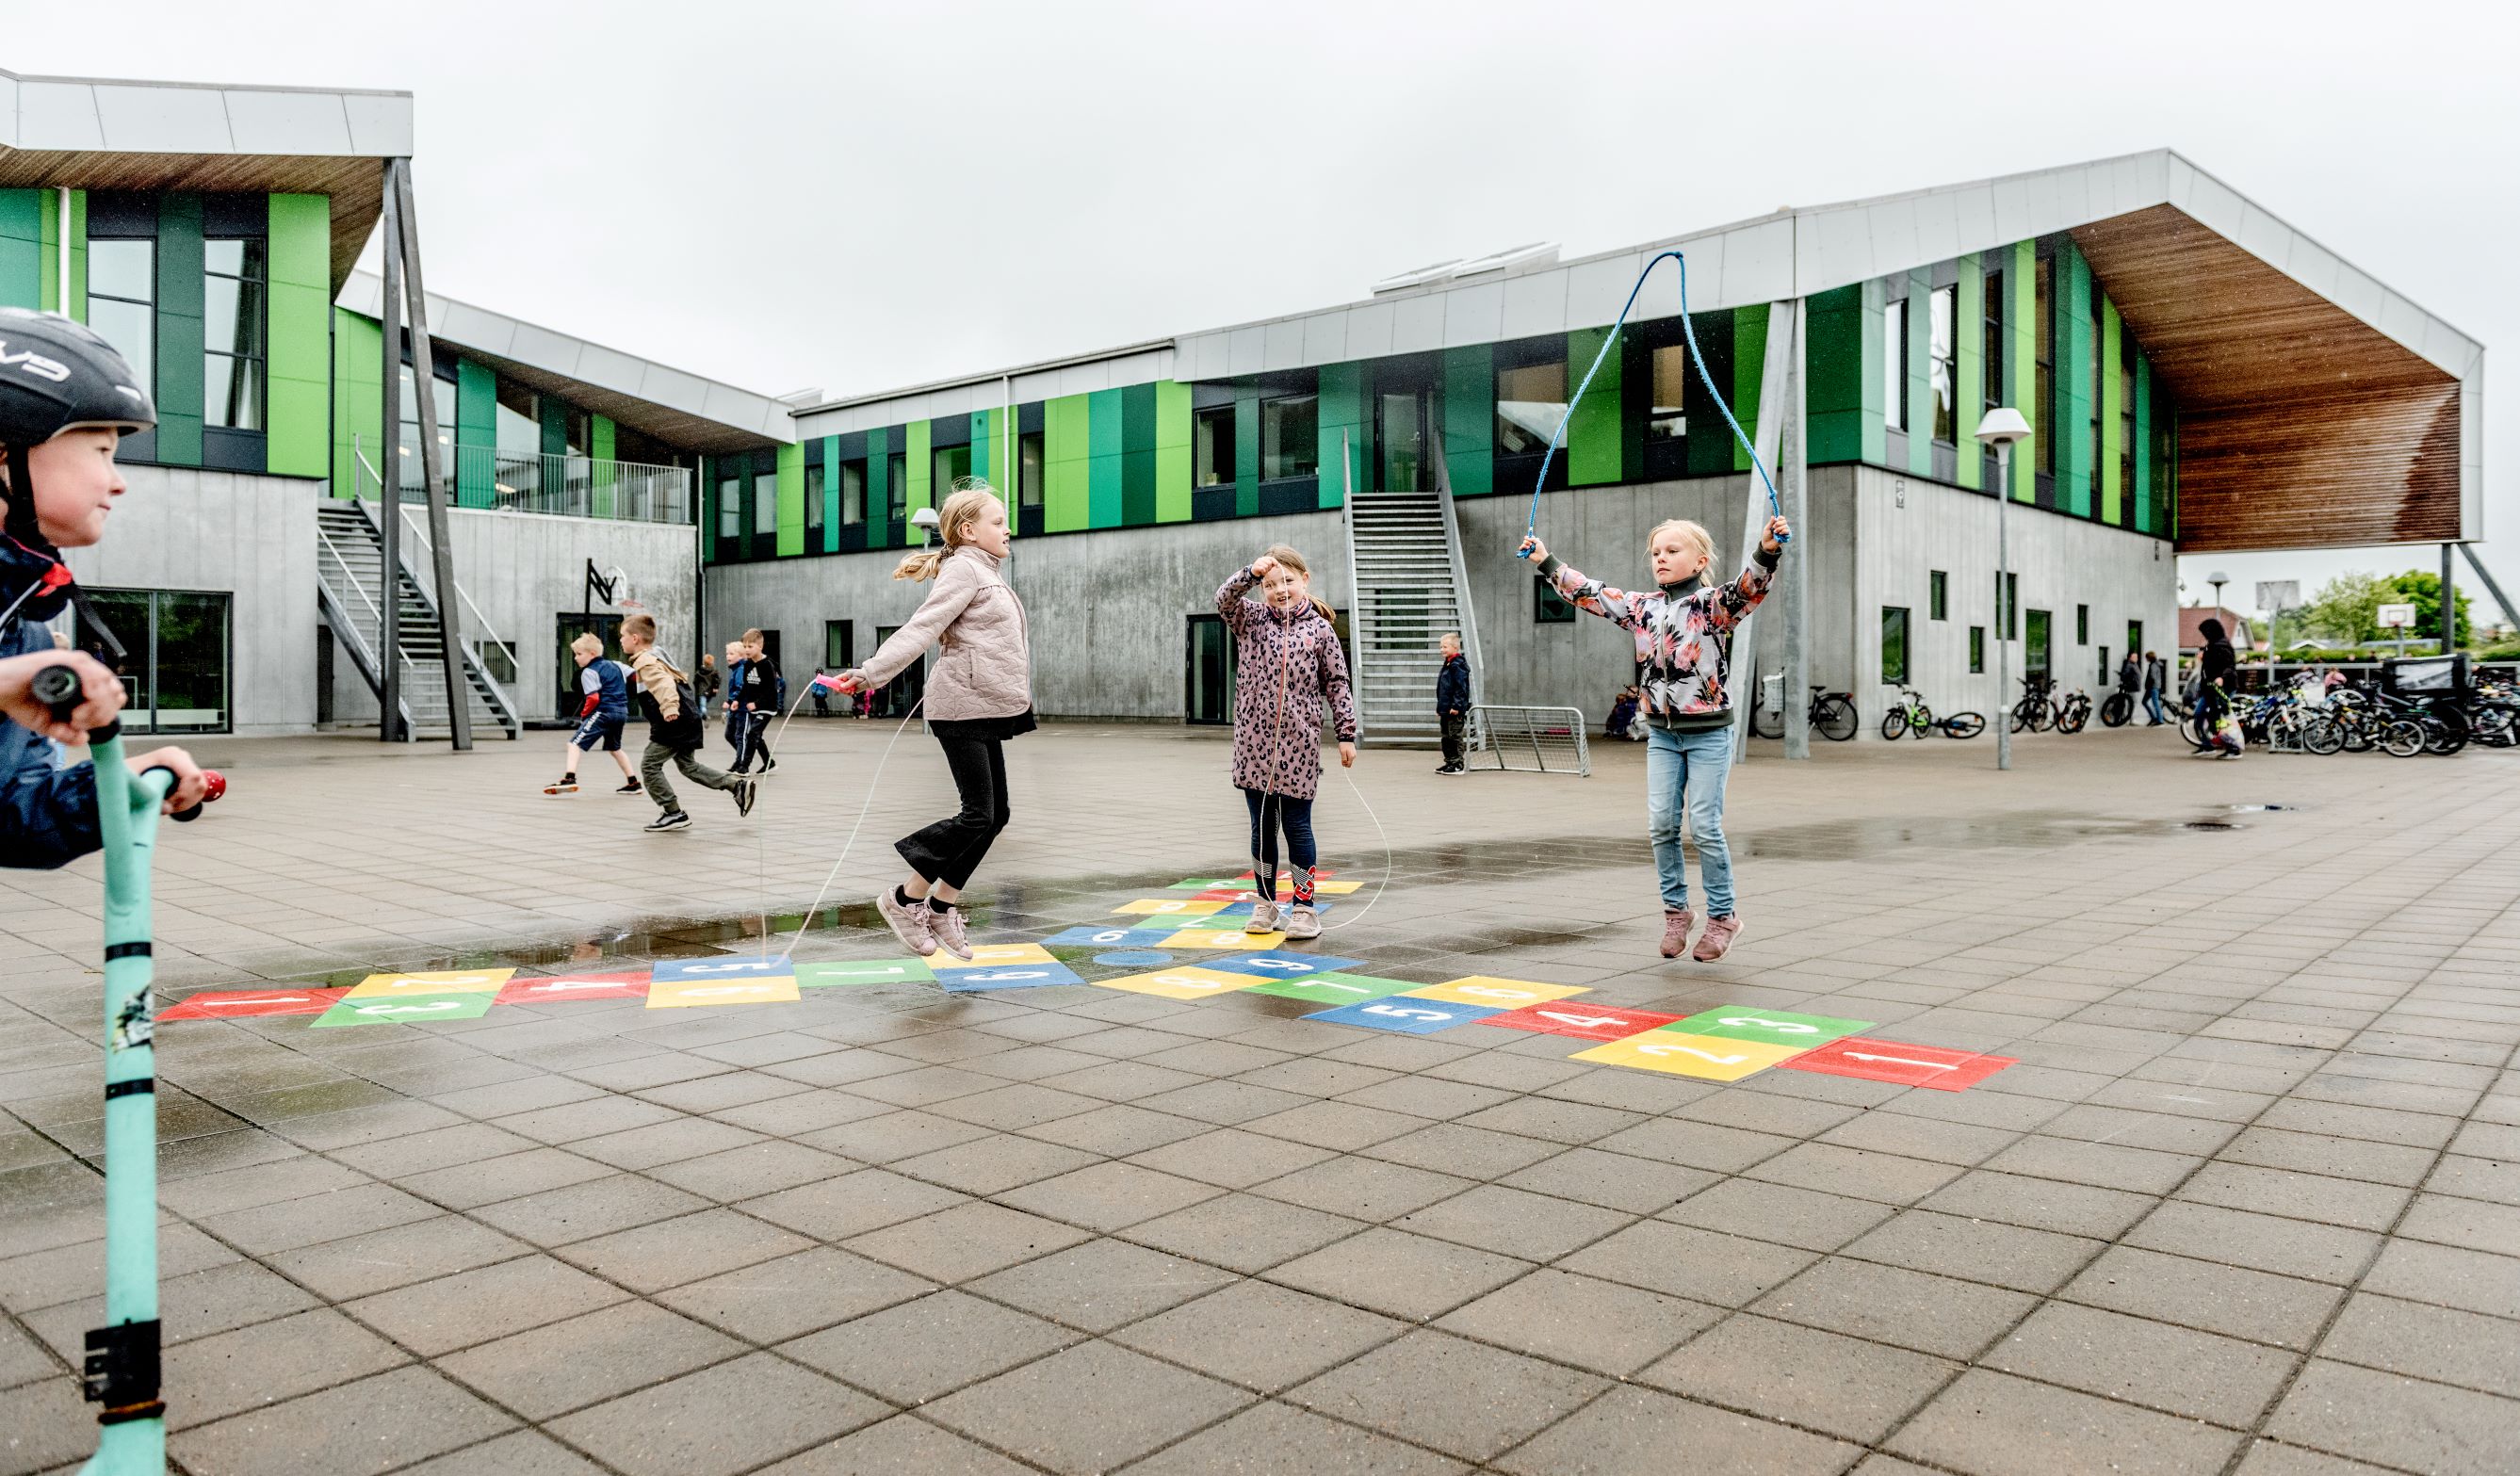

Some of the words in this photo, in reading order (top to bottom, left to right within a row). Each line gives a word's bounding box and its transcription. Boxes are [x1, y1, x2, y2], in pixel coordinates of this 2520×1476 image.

[1211, 932, 1246, 945] 8
[1152, 976, 1222, 989] 8
[203, 998, 310, 1006] 1
[355, 1001, 463, 1014] 3
[1361, 1004, 1453, 1021] 5
[1536, 1011, 1628, 1028] 4
[1717, 1016, 1819, 1033] 3
[1637, 1045, 1748, 1064] 2
[1843, 1051, 1959, 1070] 1
